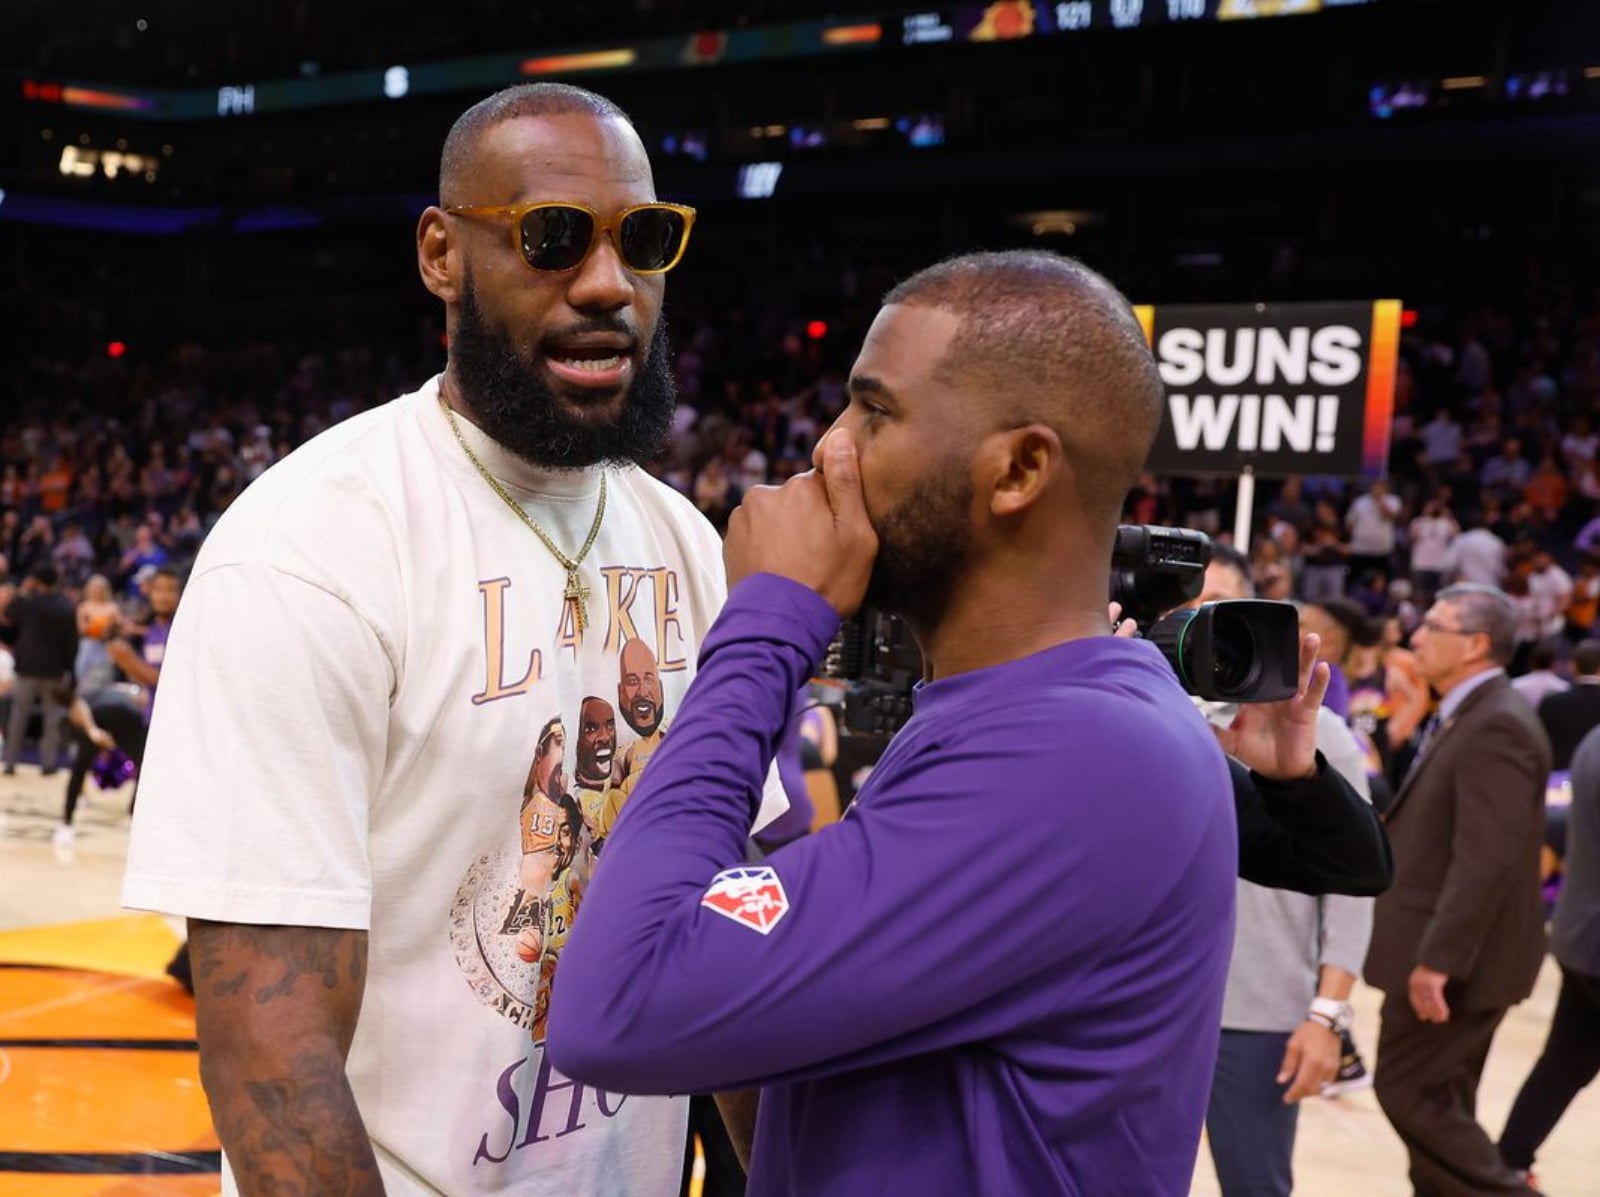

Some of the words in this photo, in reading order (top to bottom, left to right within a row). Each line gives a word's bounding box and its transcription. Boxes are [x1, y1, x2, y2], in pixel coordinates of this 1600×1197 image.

[1157, 325, 1363, 387] SUNS
[1168, 394, 1340, 453] WIN!
[530, 813, 555, 836] 13
